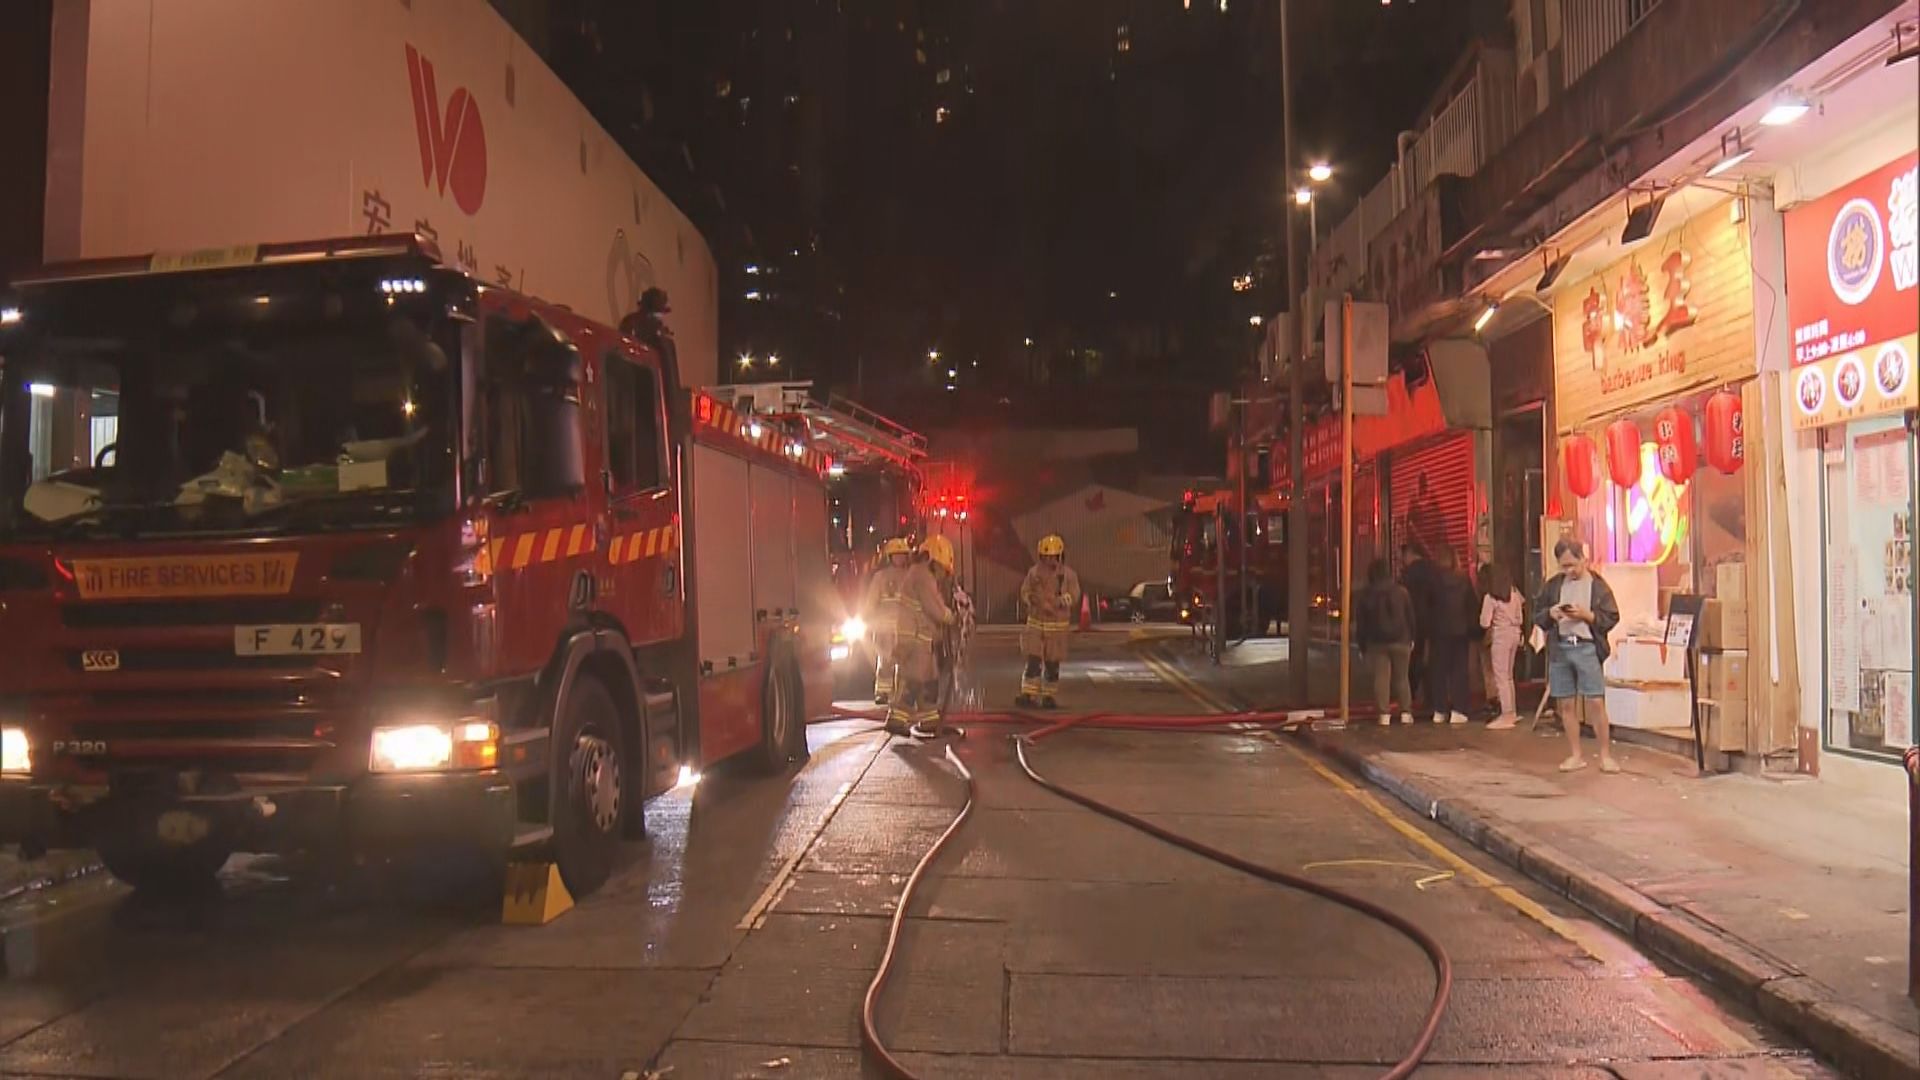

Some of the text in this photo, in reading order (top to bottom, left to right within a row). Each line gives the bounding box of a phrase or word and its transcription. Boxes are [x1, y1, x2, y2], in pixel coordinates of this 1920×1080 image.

[110, 564, 256, 589] FIRE SERVICES
[254, 628, 346, 650] F 429
[53, 741, 65, 754] P
